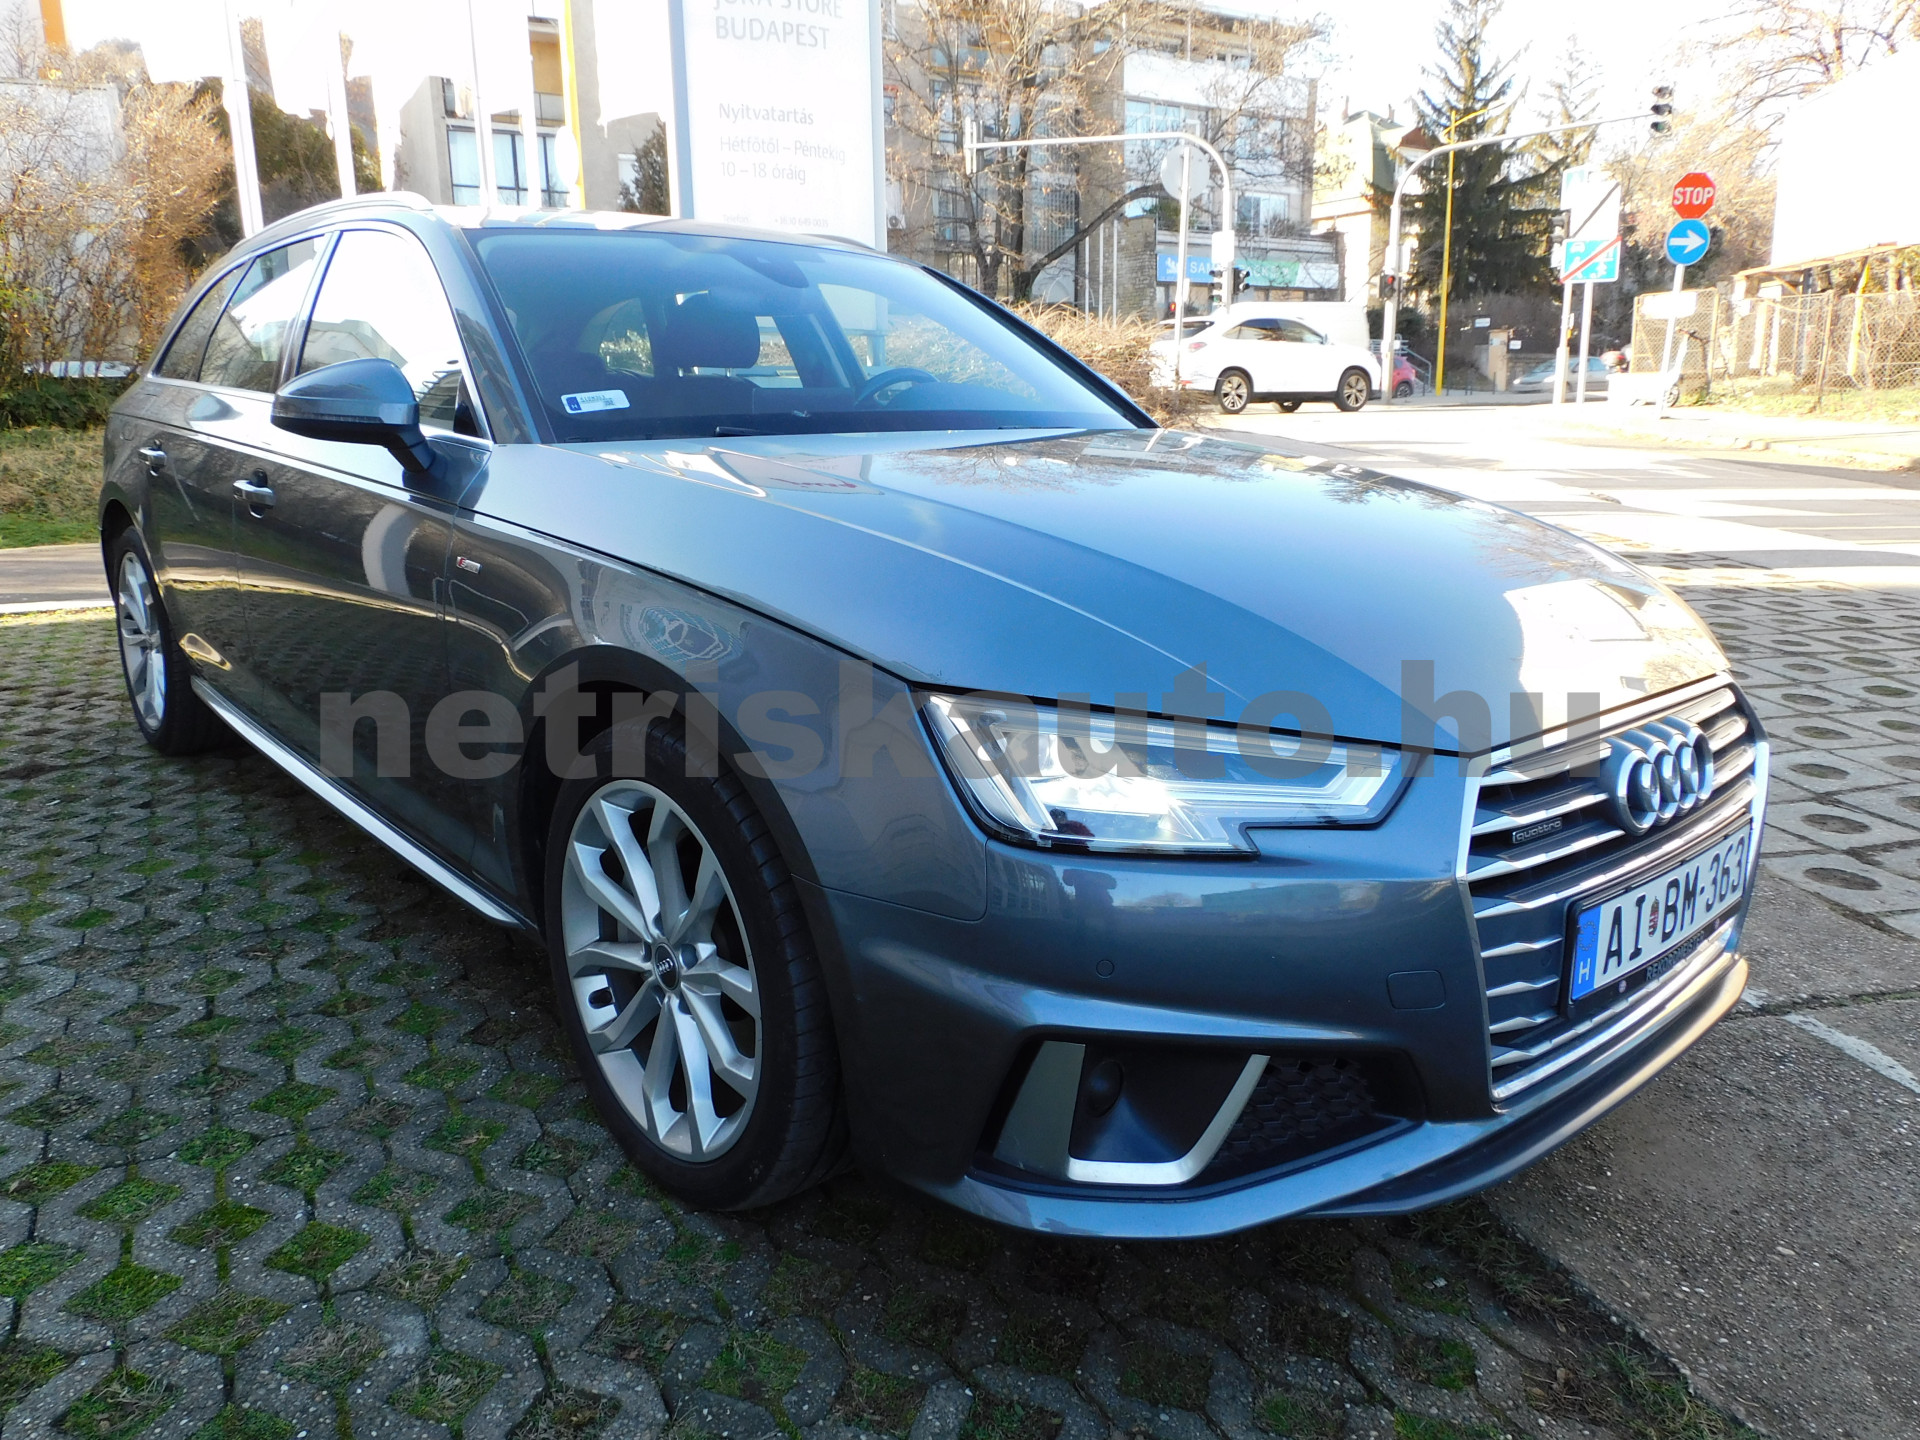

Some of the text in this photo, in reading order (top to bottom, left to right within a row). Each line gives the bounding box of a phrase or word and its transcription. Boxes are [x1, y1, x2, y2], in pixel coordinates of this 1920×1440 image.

[715, 15, 830, 50] BUDAPEST
[719, 102, 814, 125] Nyitvatartás
[720, 135, 779, 155] Hétfőtől
[794, 139, 846, 166] Péntekig
[721, 160, 736, 177] 10
[752, 161, 767, 178] 18
[771, 163, 806, 185] óráig
[1673, 186, 1715, 206] STOP
[1515, 820, 1562, 841] quattro
[1578, 833, 1746, 985] H AI BM-363
